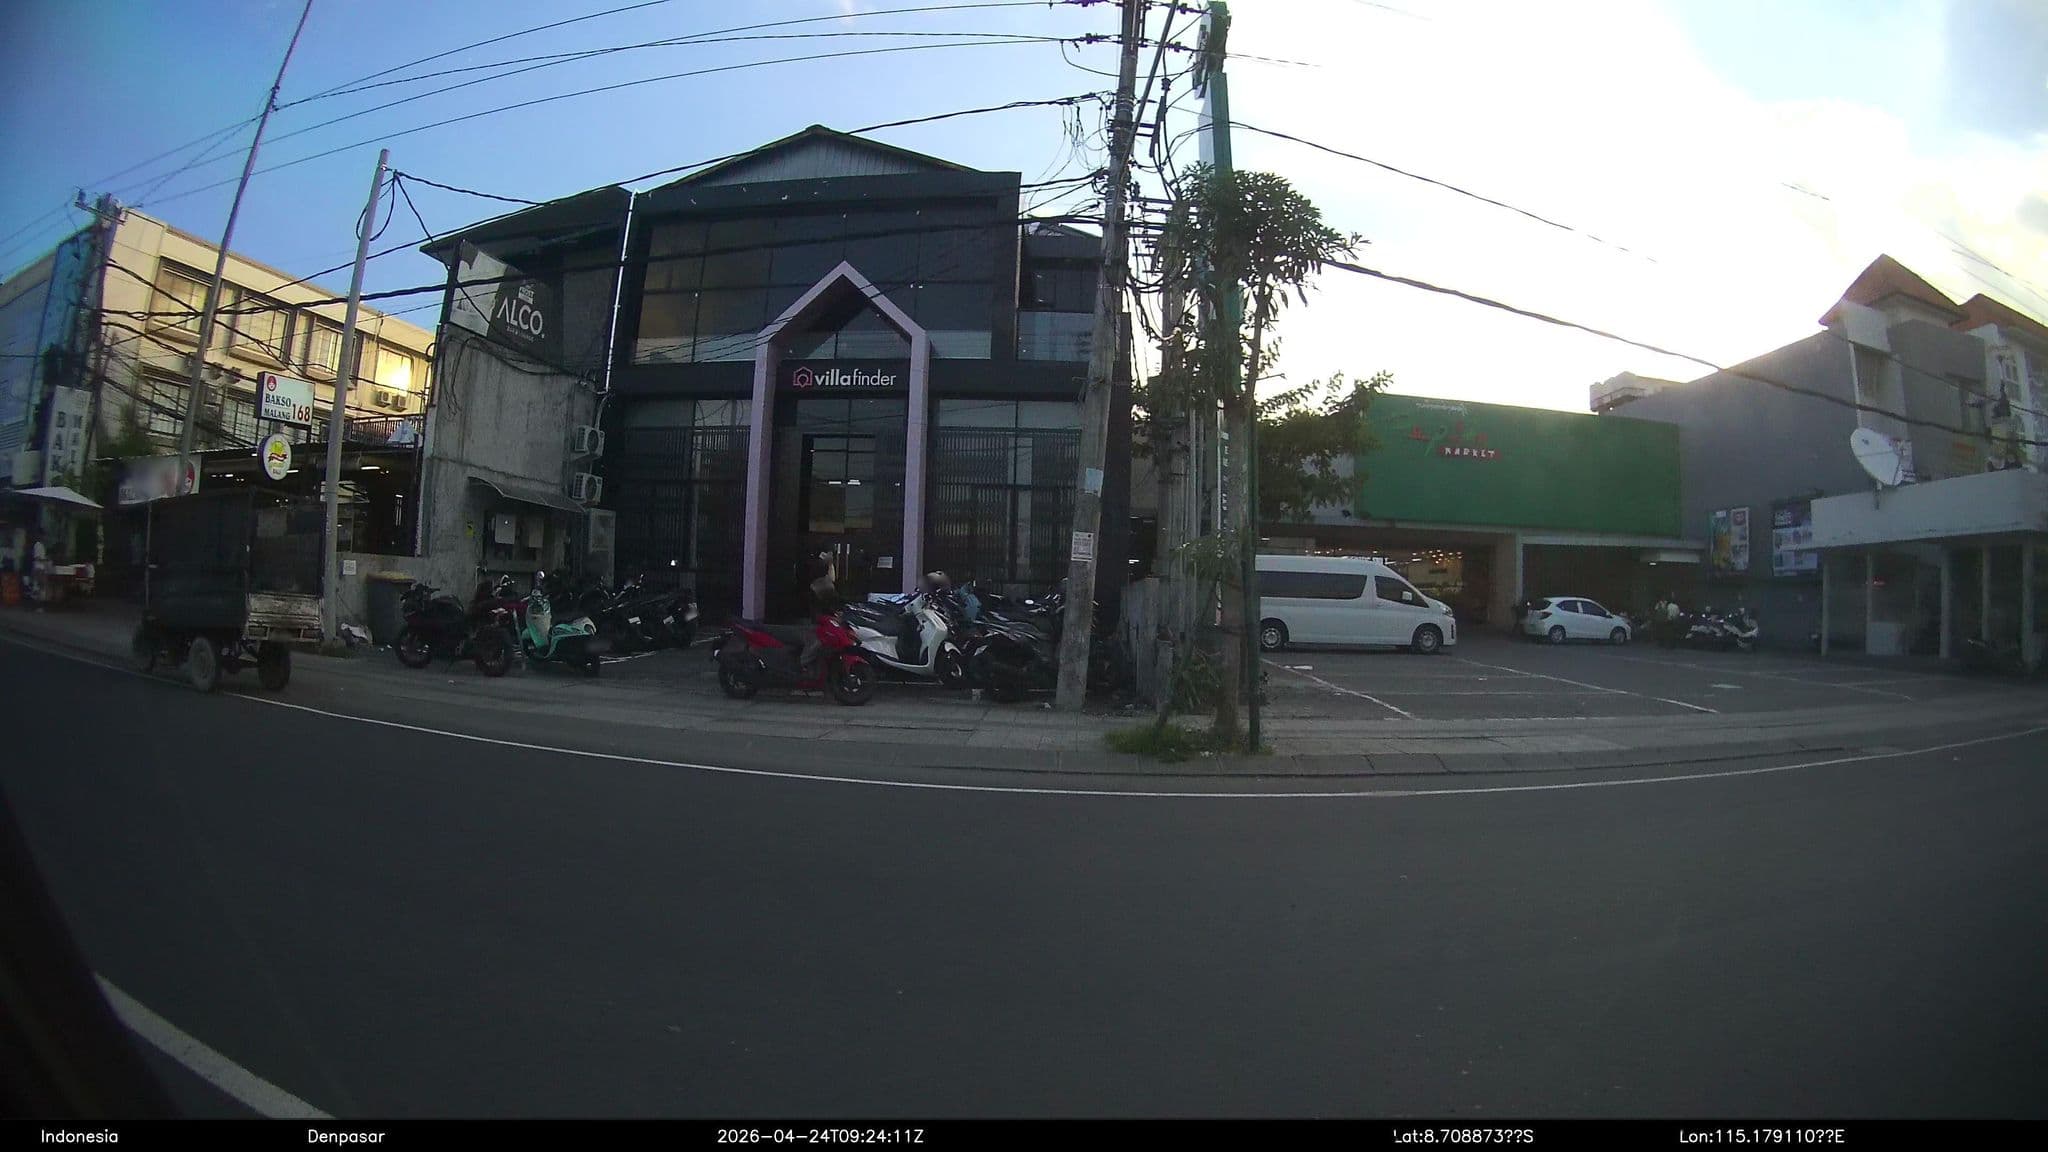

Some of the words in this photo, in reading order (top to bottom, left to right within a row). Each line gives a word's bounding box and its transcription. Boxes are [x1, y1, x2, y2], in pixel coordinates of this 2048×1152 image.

[815, 368, 897, 386] villafinder
[265, 393, 292, 408] BAKSO
[264, 407, 291, 420] MALANG
[292, 403, 311, 422] 168
